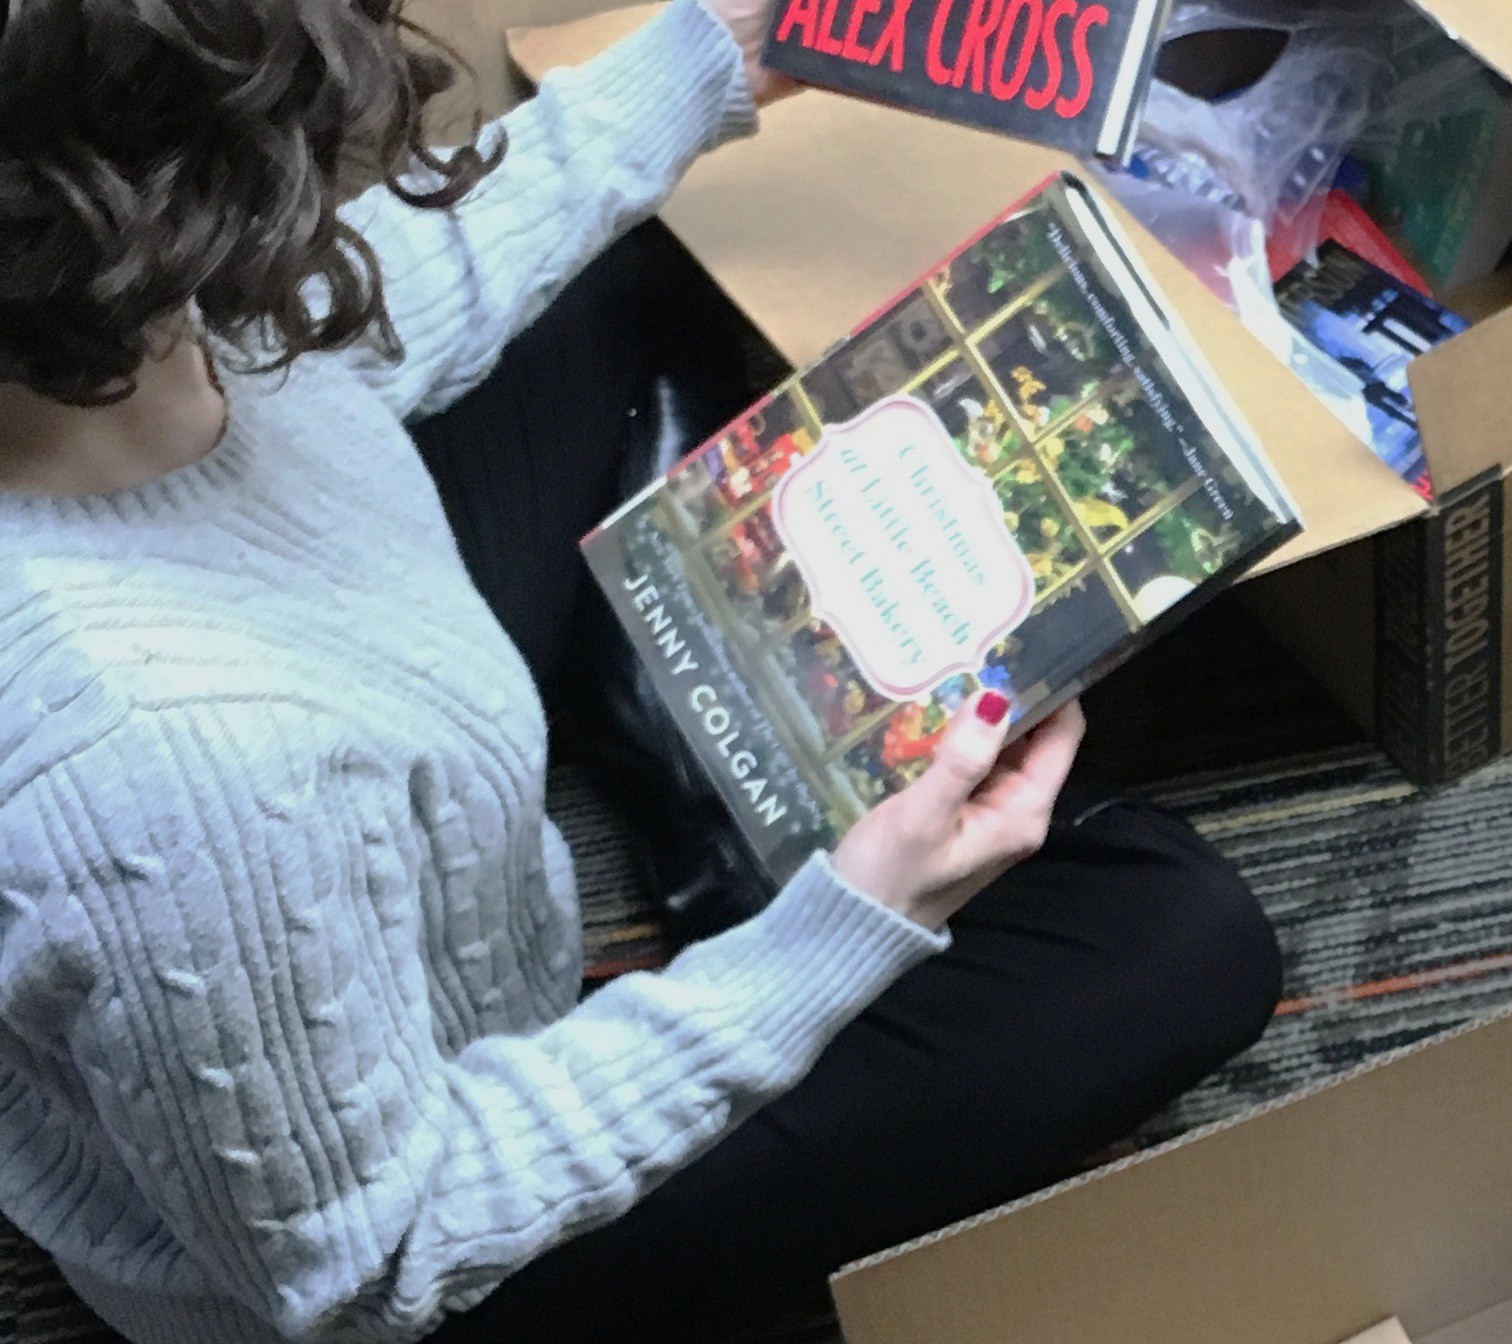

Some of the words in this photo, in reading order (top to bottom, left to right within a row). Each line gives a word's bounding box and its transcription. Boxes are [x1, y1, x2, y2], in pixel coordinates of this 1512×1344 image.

[804, 479, 866, 565] Street
[859, 567, 928, 666] Bakery
[839, 448, 868, 474] at
[860, 477, 912, 553] Little
[910, 558, 972, 646] Beach
[899, 445, 986, 586] Christmas
[1444, 492, 1491, 675] TOGETHER
[622, 574, 701, 677] JENNY
[685, 683, 789, 828] COLGAN
